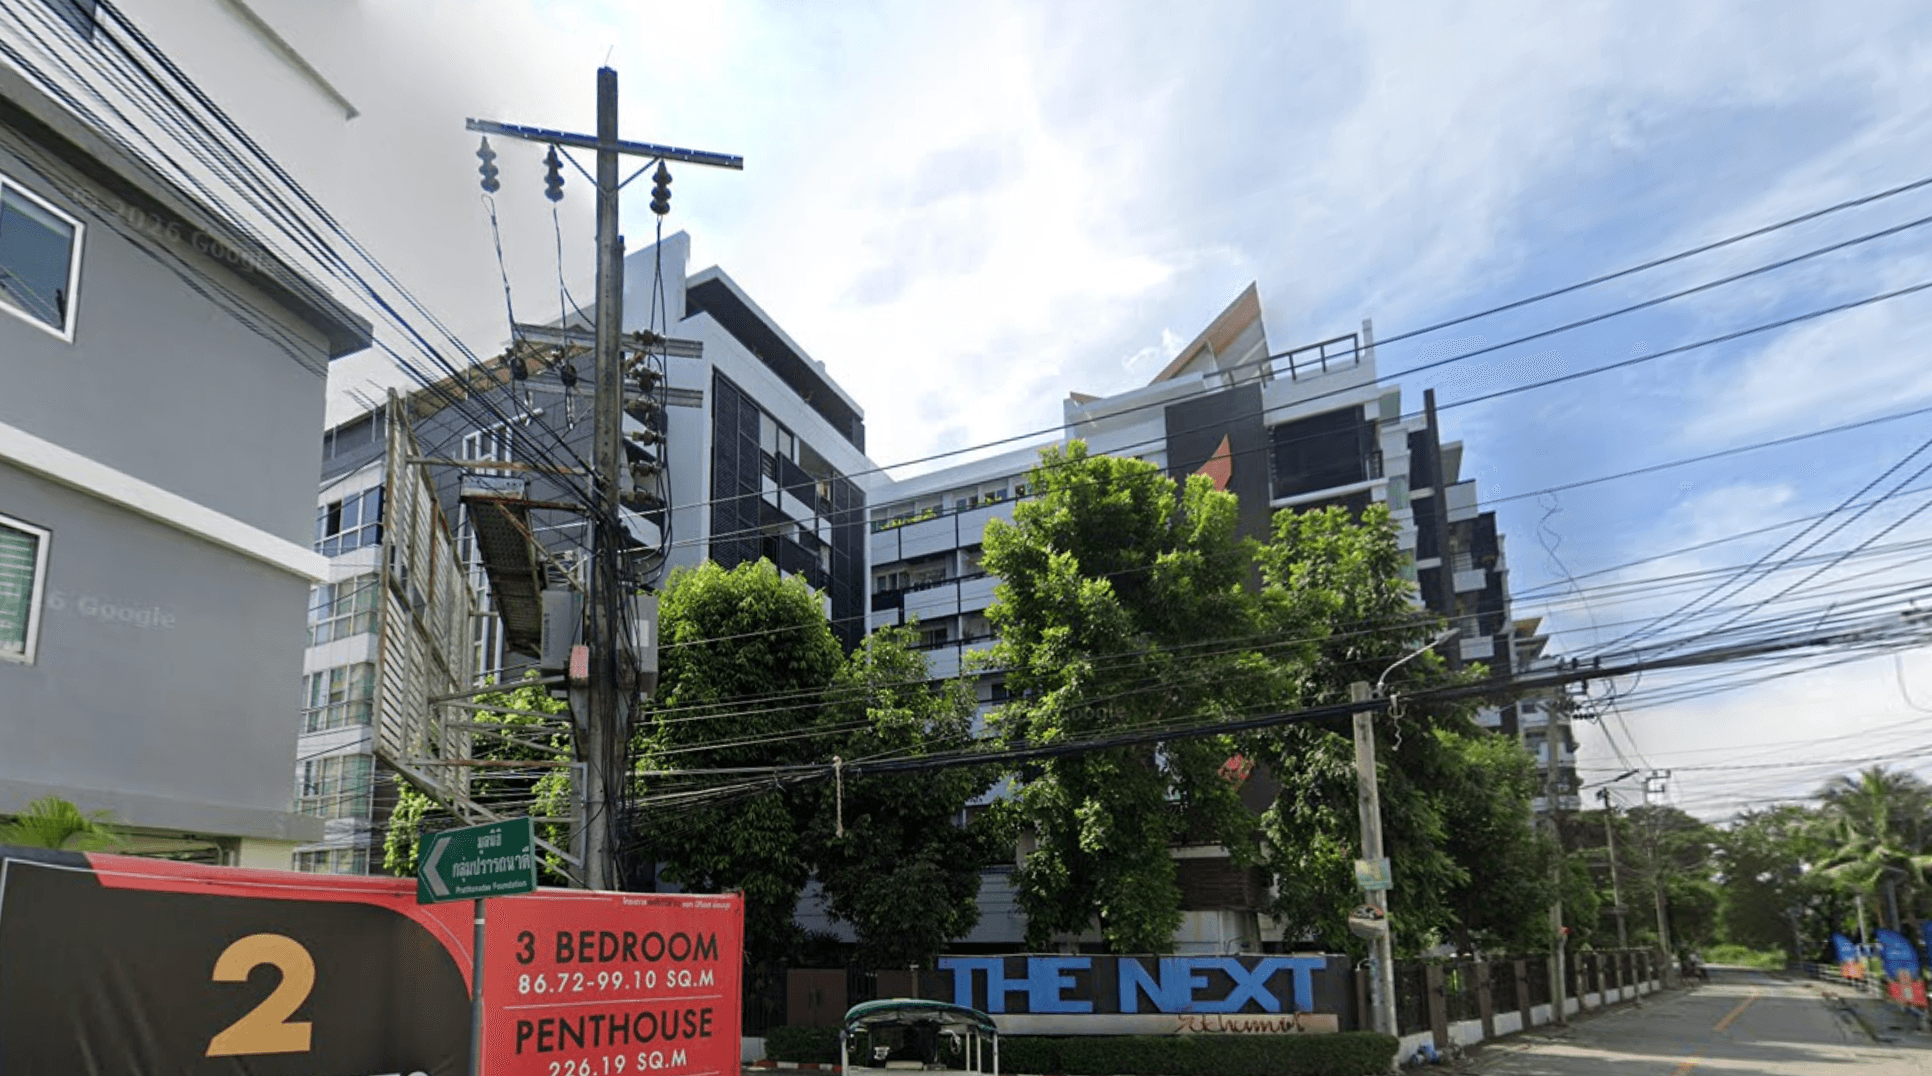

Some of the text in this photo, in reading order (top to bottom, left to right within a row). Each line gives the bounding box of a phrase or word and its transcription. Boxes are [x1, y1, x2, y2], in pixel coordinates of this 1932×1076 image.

[492, 880, 527, 890] Foundation
[515, 930, 719, 965] 3 BEDROOM
[206, 933, 315, 1058] 2
[517, 969, 715, 995] 86.72-99.10 SQ.M
[938, 957, 1327, 1014] THE NEXT
[515, 1008, 713, 1055] PENTHOUSE
[549, 1049, 687, 1076] 226.19 SQ.M
